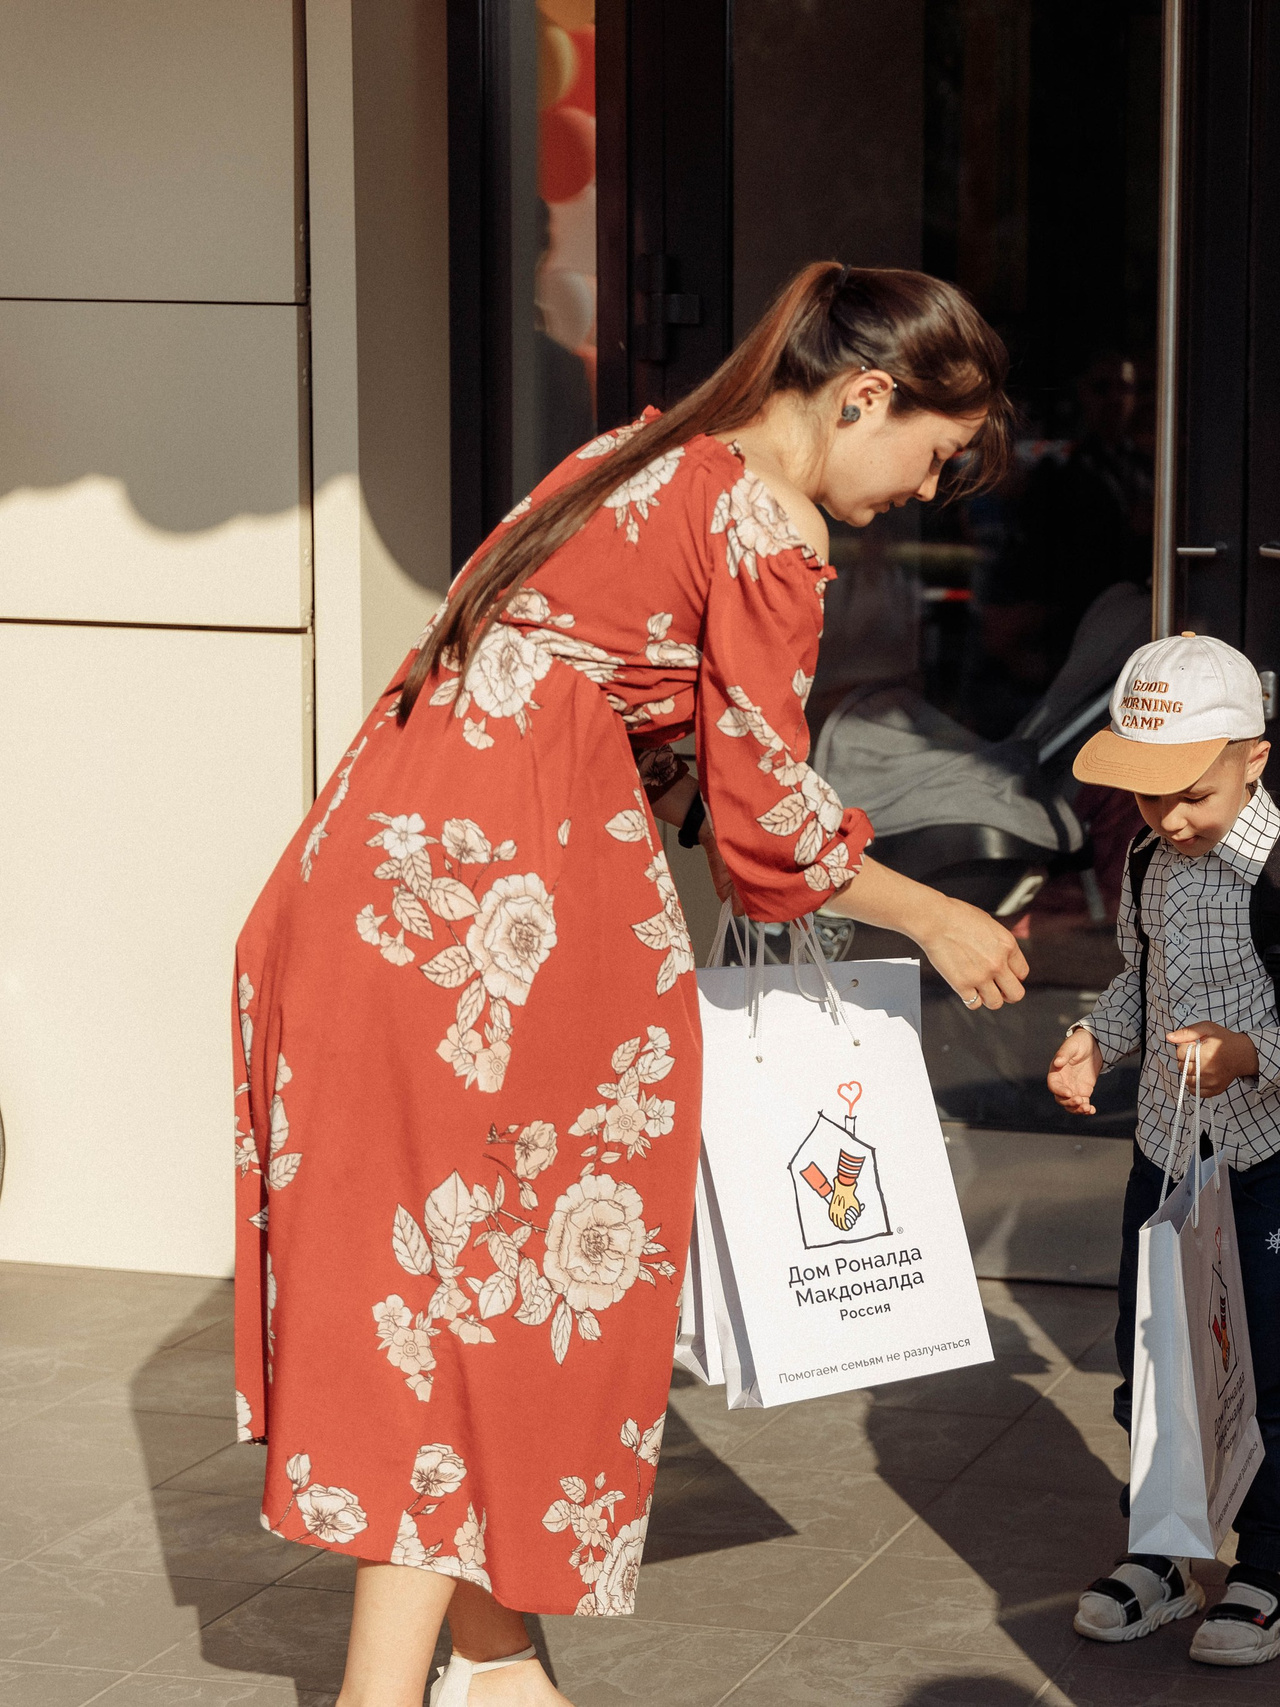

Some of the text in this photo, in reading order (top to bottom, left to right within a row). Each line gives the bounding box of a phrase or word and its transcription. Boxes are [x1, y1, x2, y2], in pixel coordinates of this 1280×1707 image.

[1132, 679, 1170, 694] GOOD
[1121, 715, 1165, 731] CAMP
[788, 1247, 923, 1288] Дом Роналда
[795, 1271, 925, 1307] Макдоналда
[839, 1302, 892, 1321] Россия
[778, 1337, 971, 1384] Помогаем семьям не разлучаться
